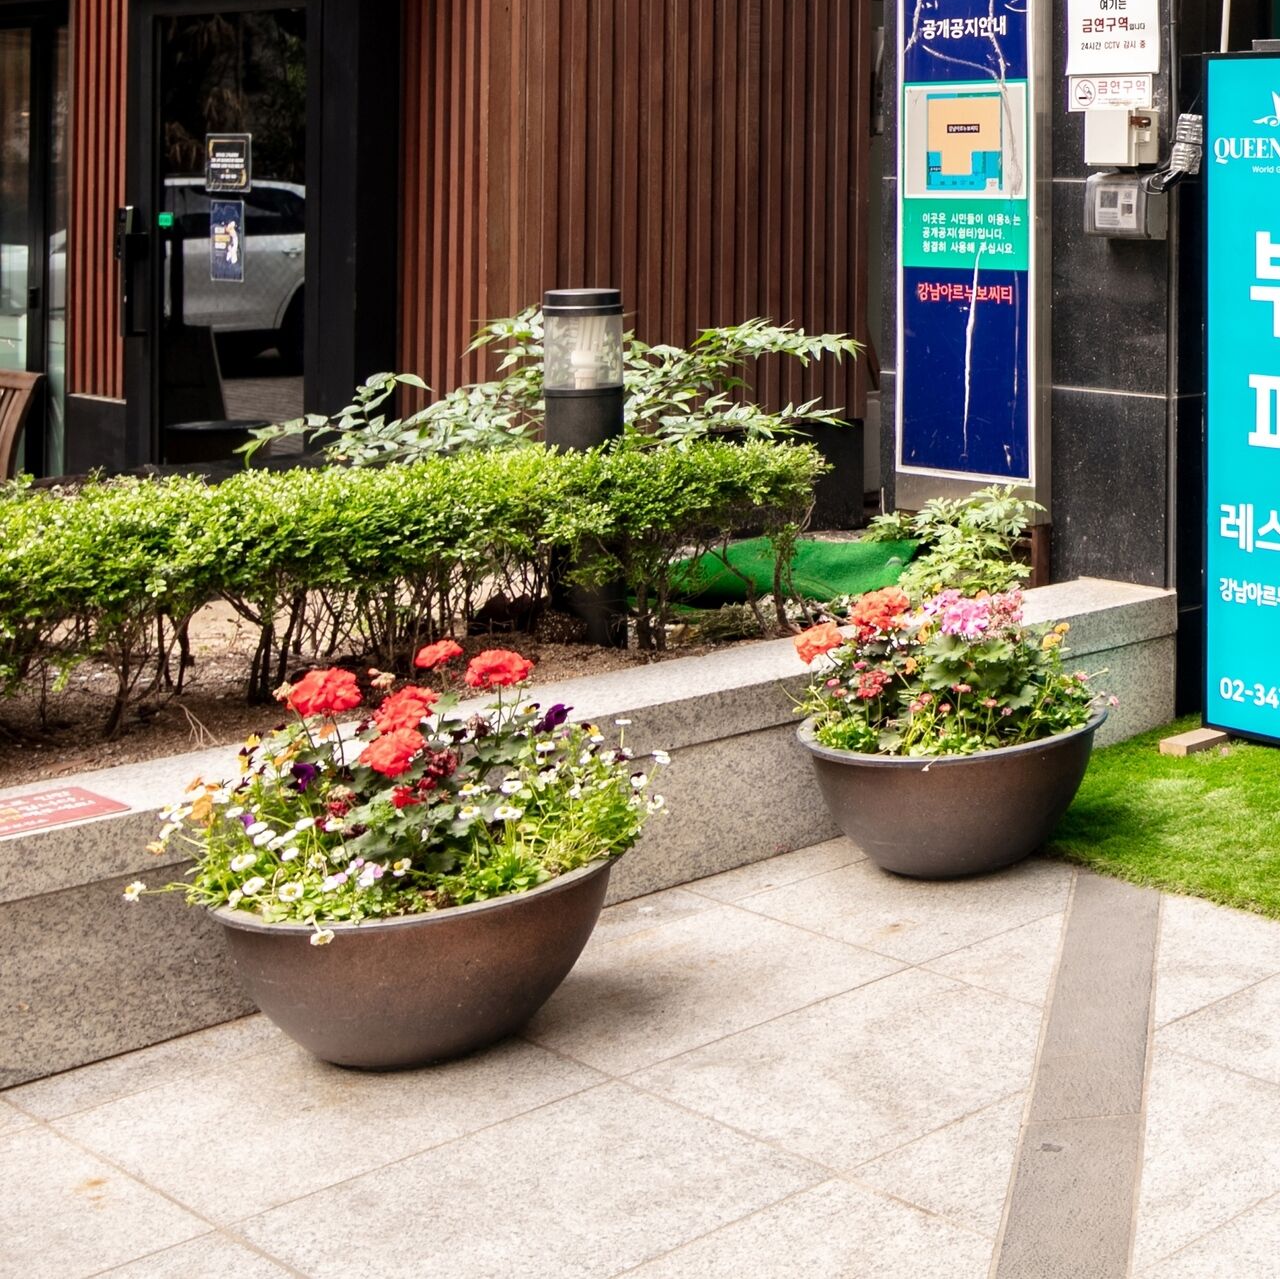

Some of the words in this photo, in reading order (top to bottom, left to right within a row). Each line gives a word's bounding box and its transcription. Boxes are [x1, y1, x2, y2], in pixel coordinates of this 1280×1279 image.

[922, 15, 1006, 40] 공개공지안내
[1081, 42, 1102, 50] 24시간
[1104, 41, 1120, 50] CCTV
[1098, 80, 1146, 94] 금연구역
[1252, 165, 1273, 174] World
[922, 213, 946, 225] 이곳은
[951, 213, 983, 225] 시민들이
[923, 241, 946, 253] 청결히
[951, 241, 975, 253] 사용해
[918, 282, 1012, 305] 강남아르누보씨티
